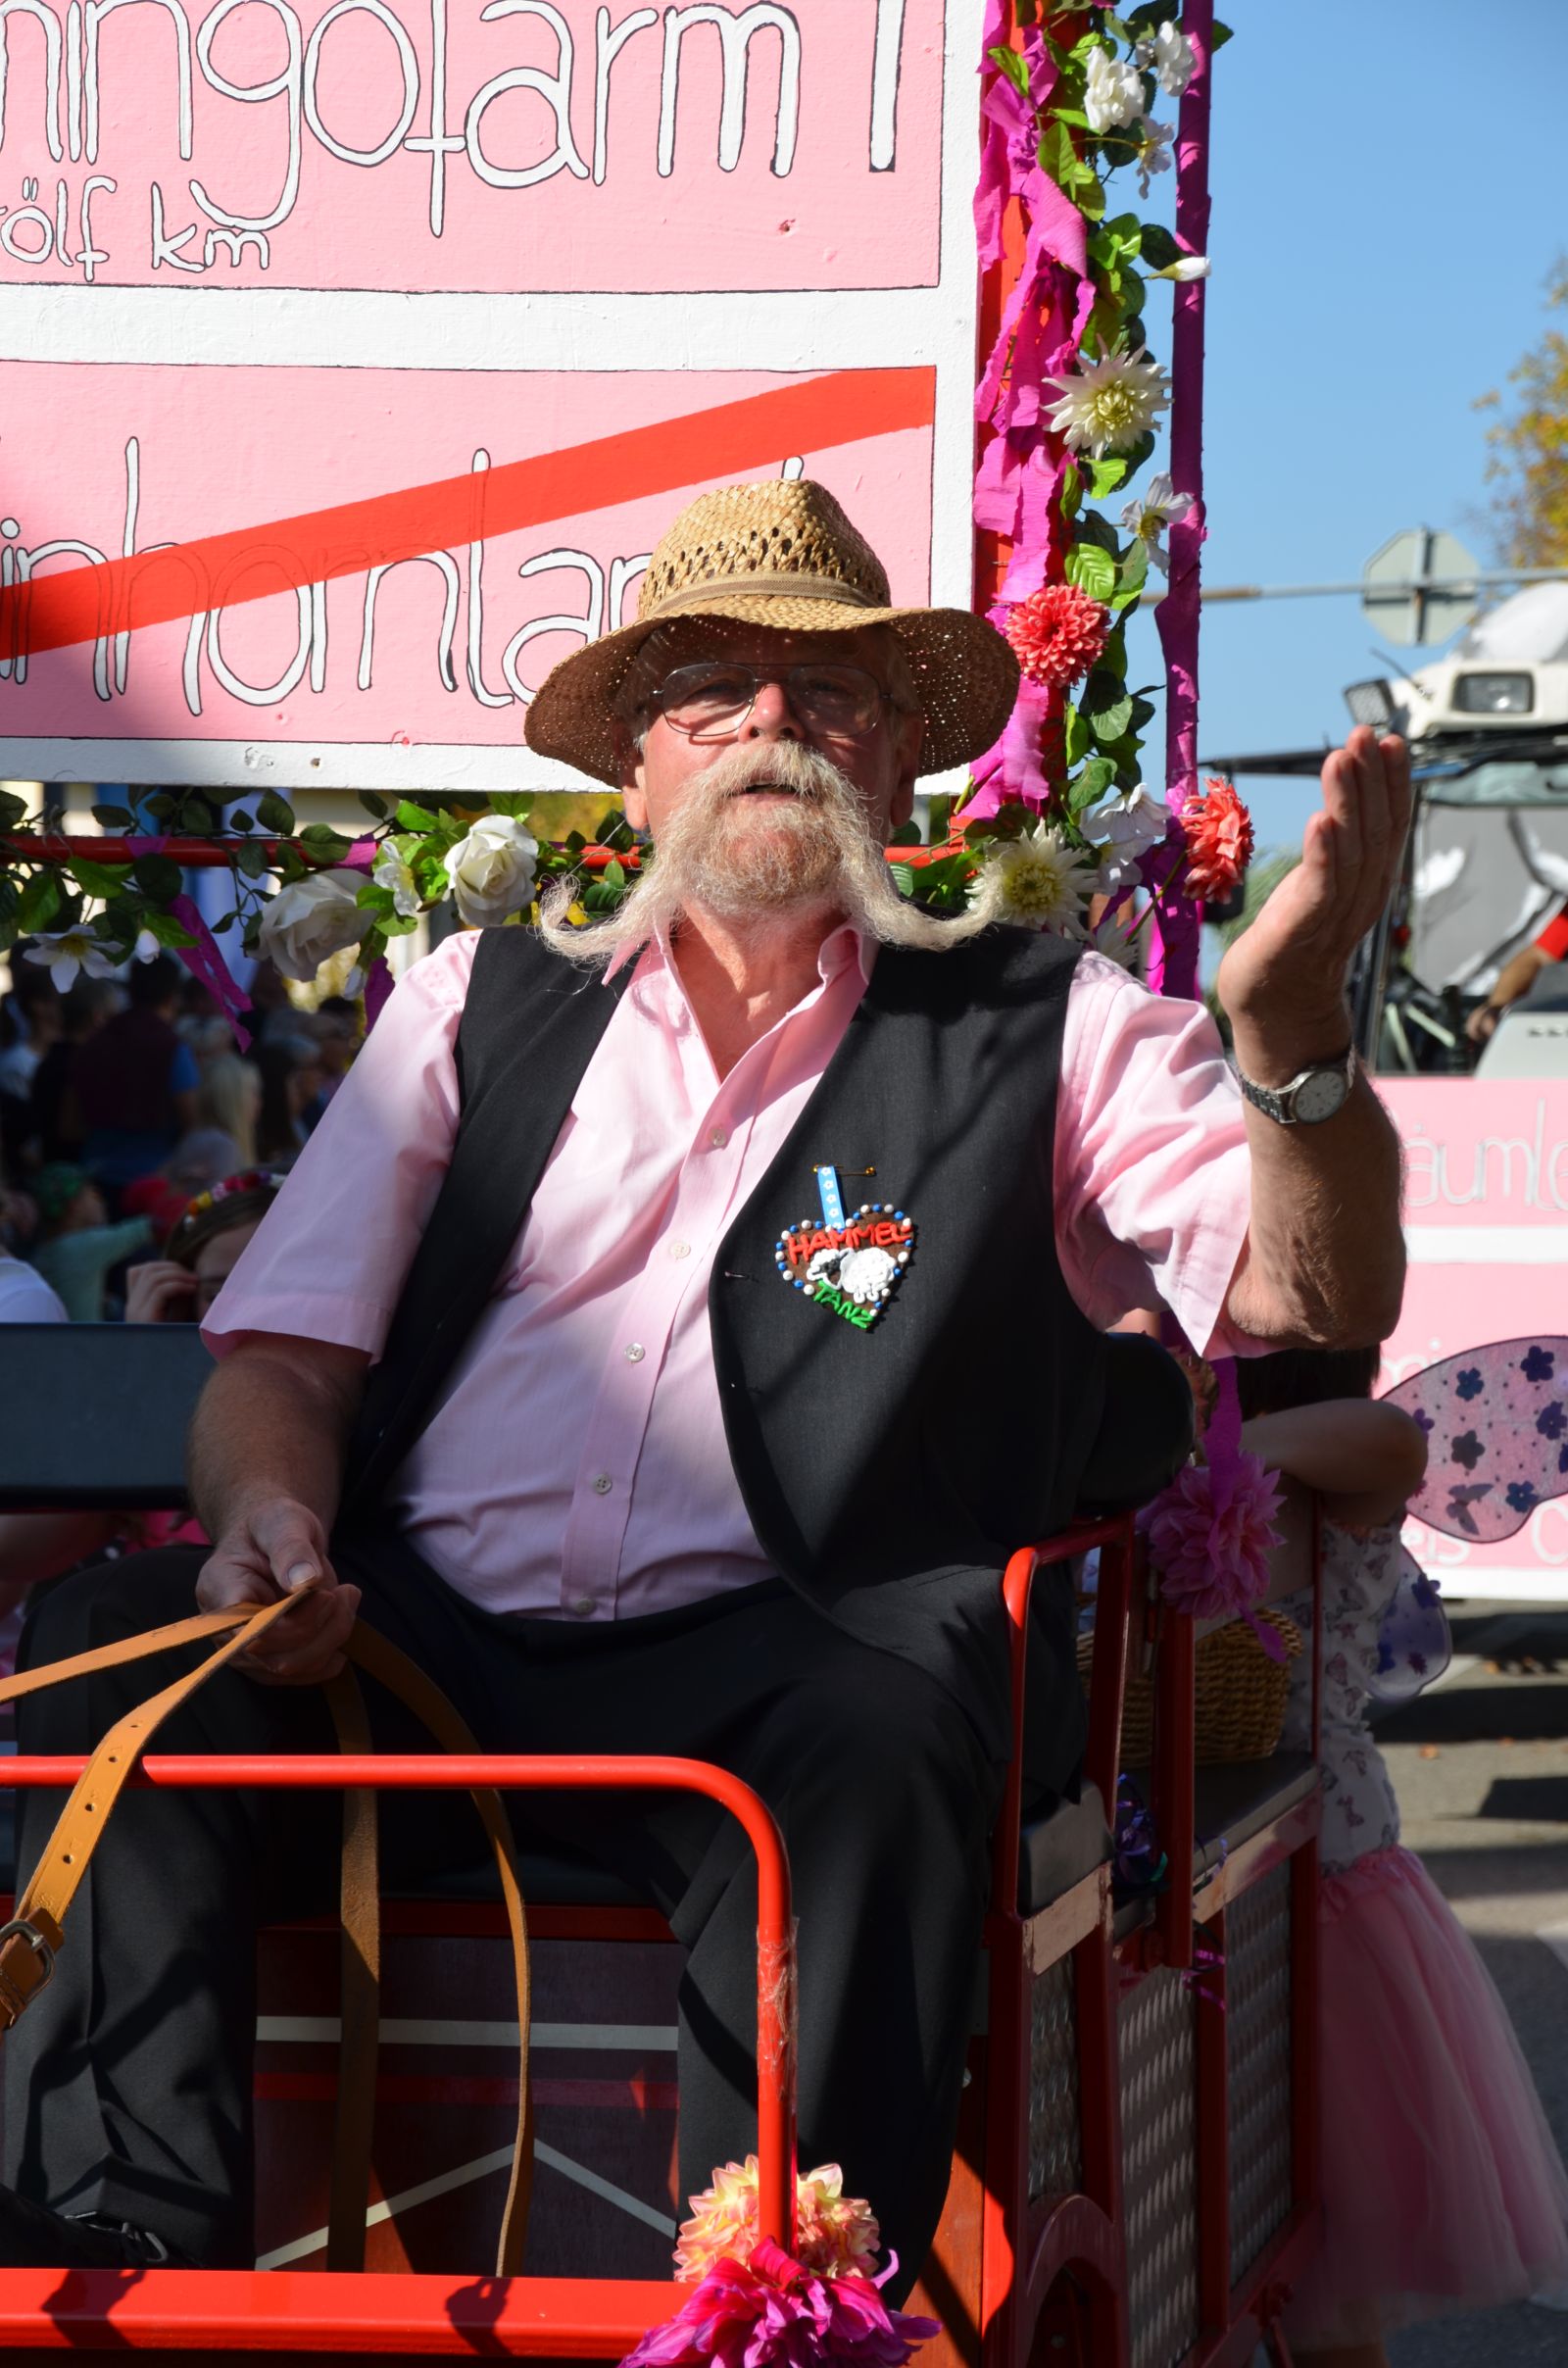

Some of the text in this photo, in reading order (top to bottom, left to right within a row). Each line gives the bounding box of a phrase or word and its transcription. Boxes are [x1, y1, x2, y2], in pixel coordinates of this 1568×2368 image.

[151, 180, 270, 273] km
[787, 1221, 911, 1265] HAMMEL
[812, 1278, 875, 1330] TANZ
